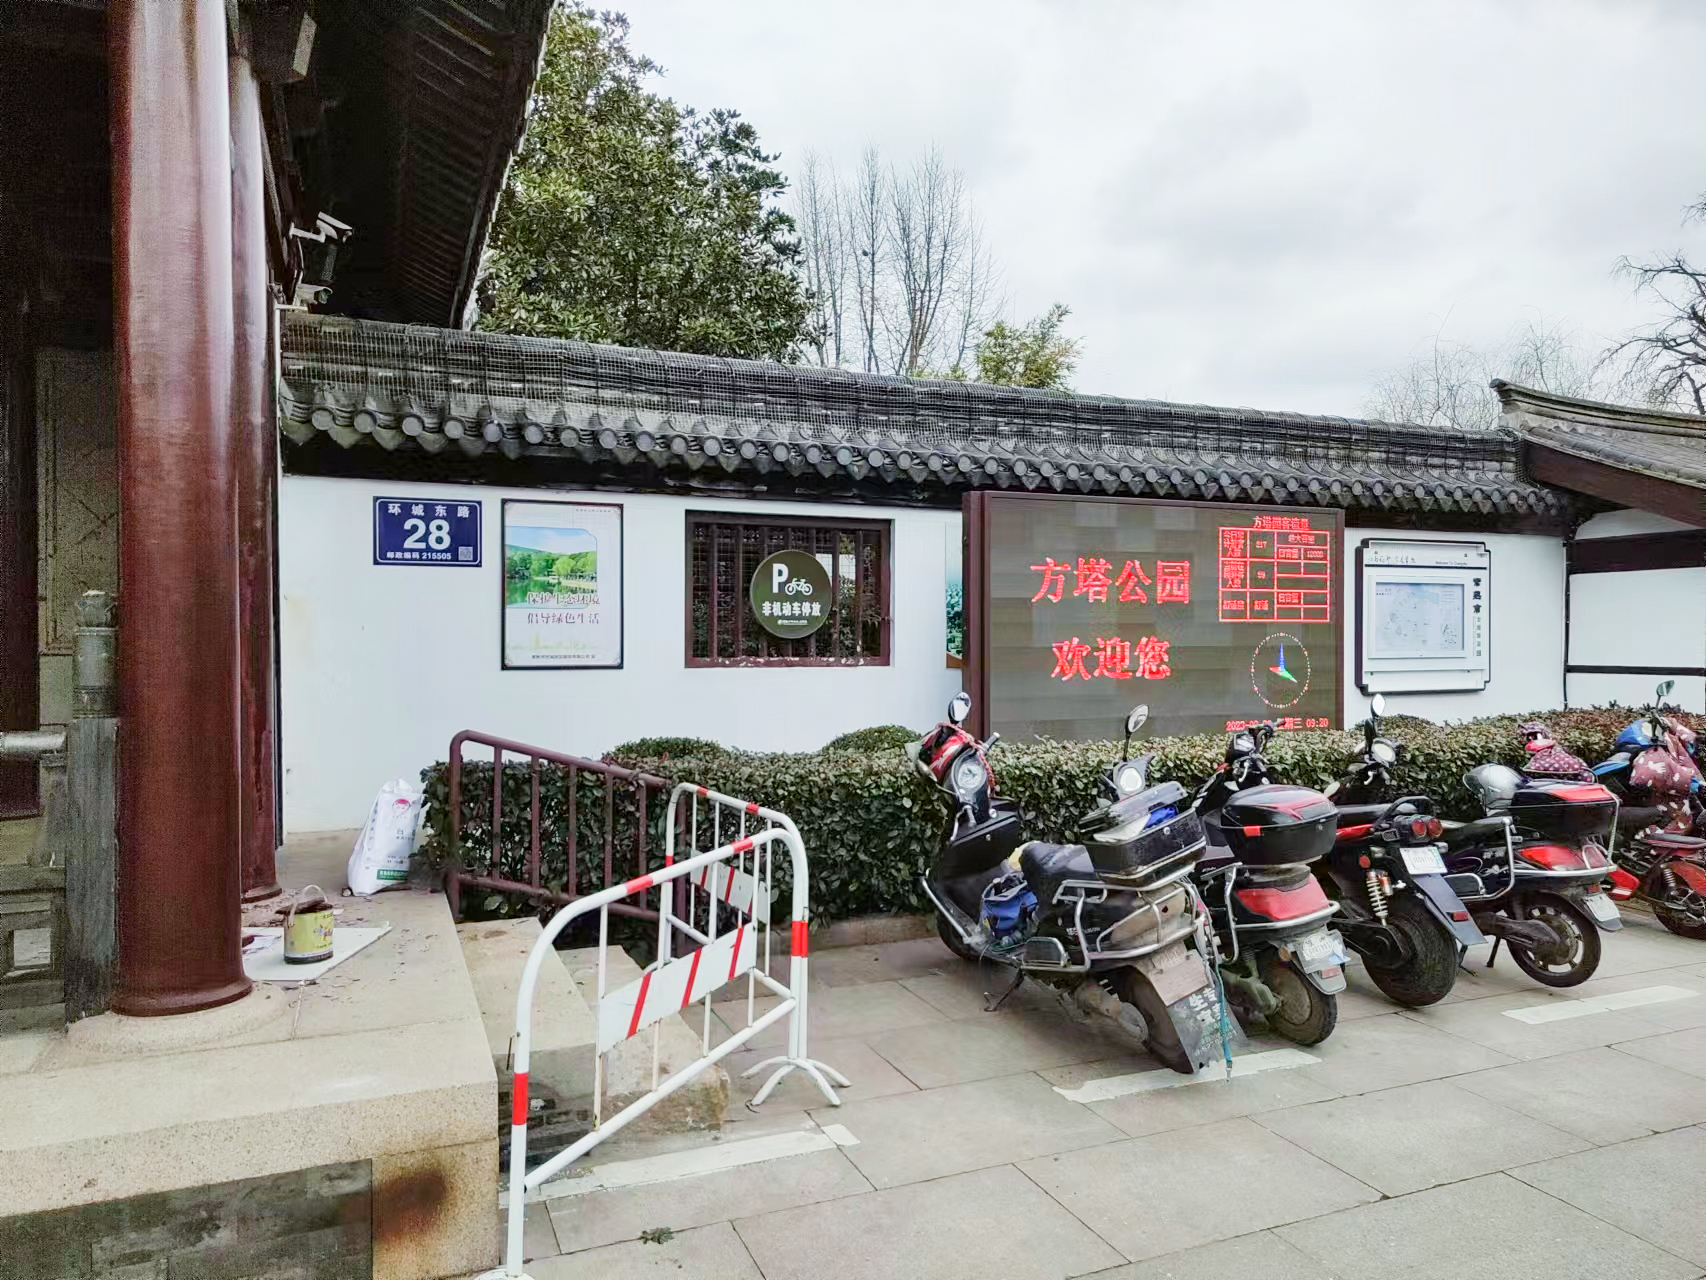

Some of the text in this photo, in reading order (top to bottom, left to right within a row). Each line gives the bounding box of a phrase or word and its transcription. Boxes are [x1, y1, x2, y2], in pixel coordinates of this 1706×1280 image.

[387, 503, 470, 518] 环城东路
[403, 518, 451, 550] 28
[386, 551, 452, 560] 邮政编码 215505
[772, 563, 788, 593] P
[1030, 557, 1191, 604] 方塔公园
[527, 591, 600, 605] 保护生态环境
[762, 601, 821, 617] 非机动车停放
[527, 612, 600, 625] 倡导绿色生活
[1050, 636, 1171, 681] 欢迎您
